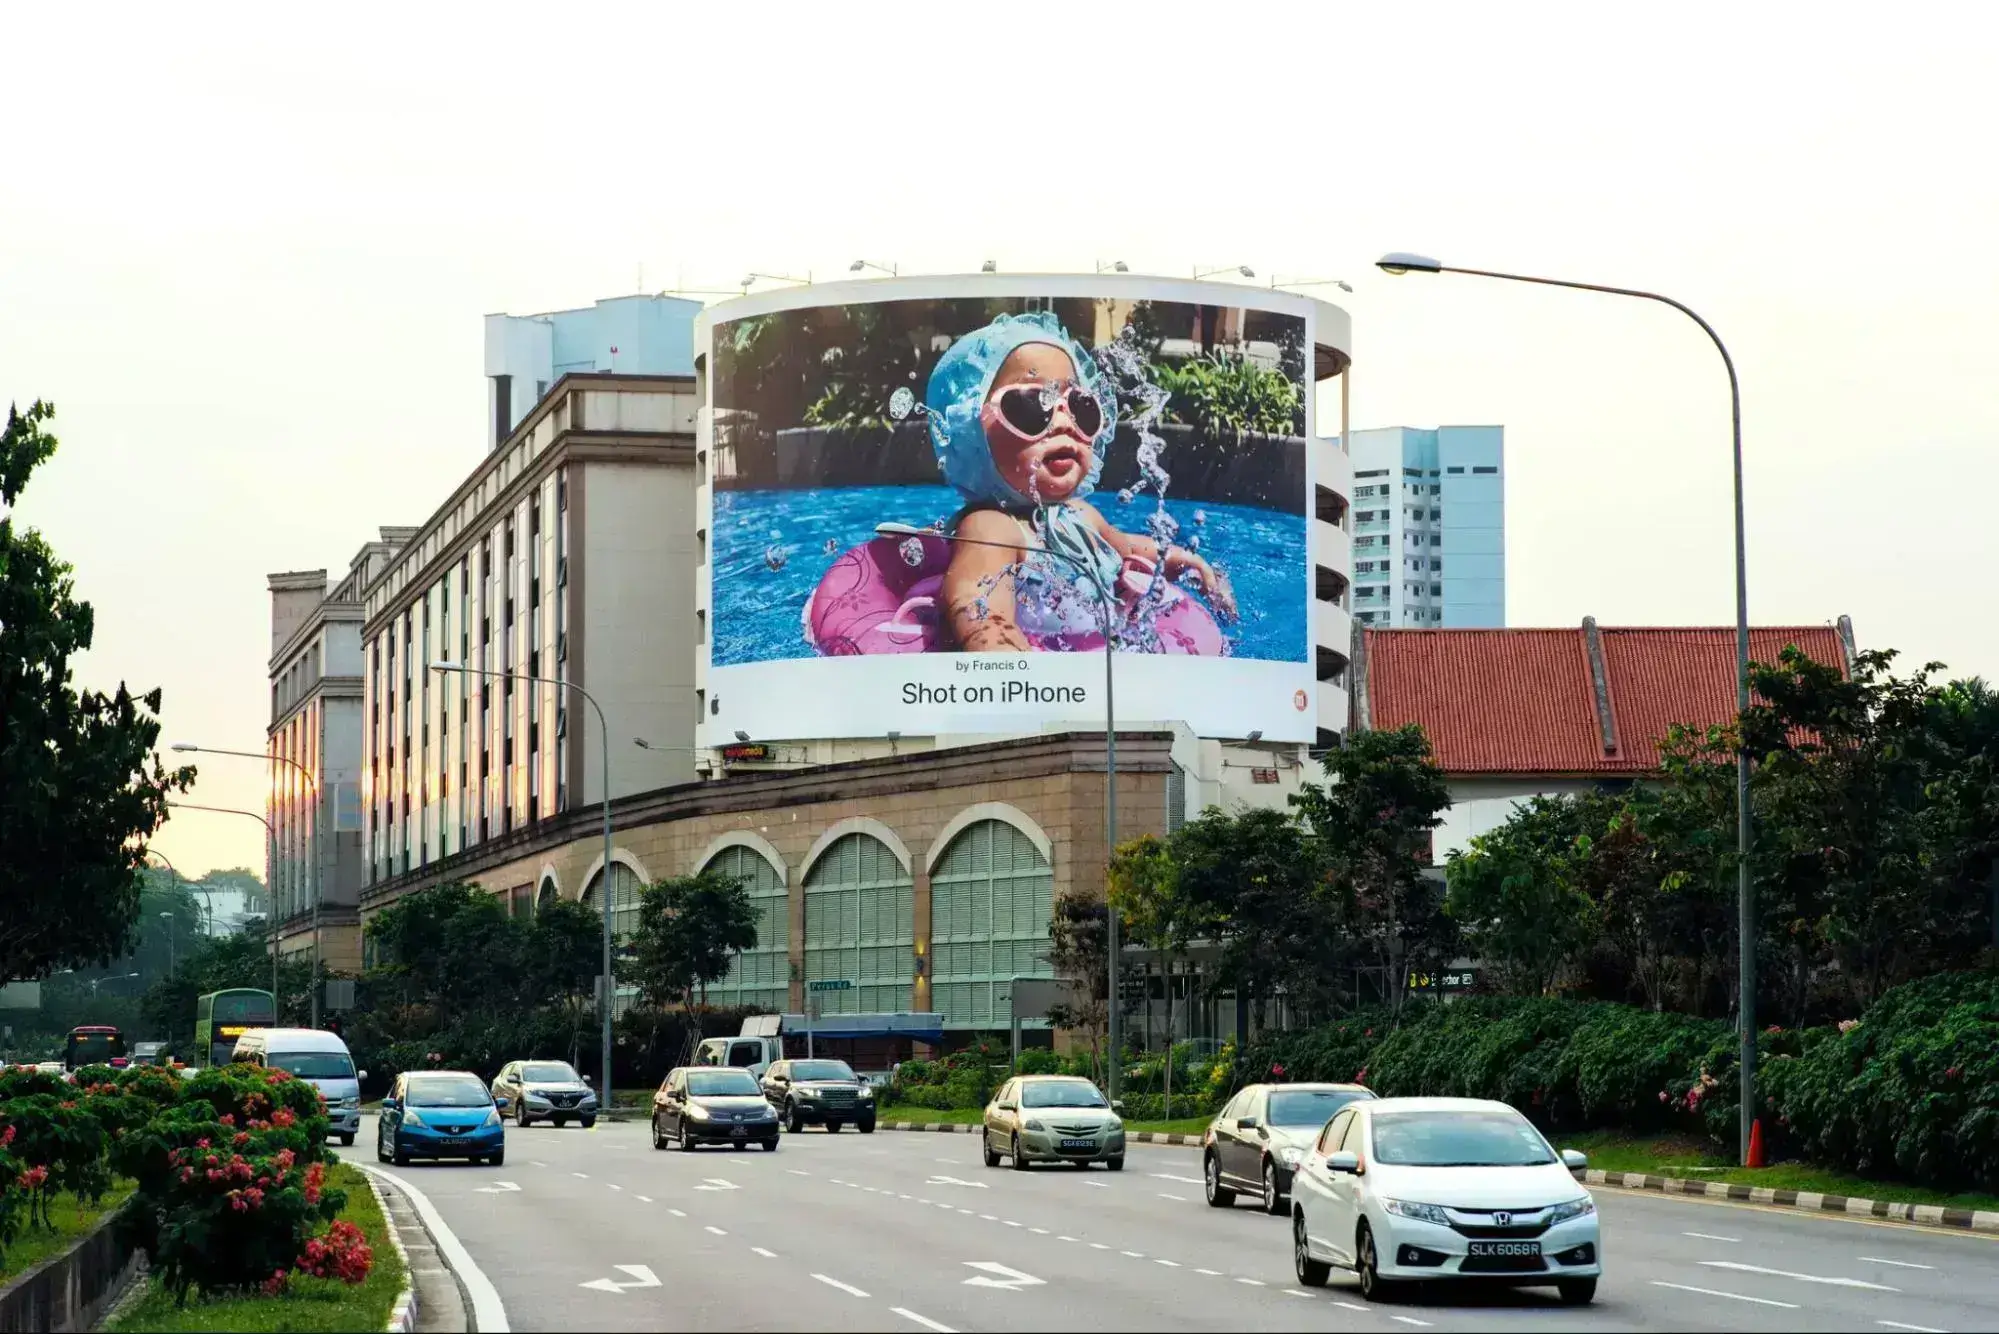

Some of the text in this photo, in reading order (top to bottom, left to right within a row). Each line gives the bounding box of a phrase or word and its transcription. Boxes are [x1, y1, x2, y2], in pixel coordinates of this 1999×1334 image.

[956, 660, 1030, 672] by Francis O.
[902, 681, 1086, 704] Shot on iPhone
